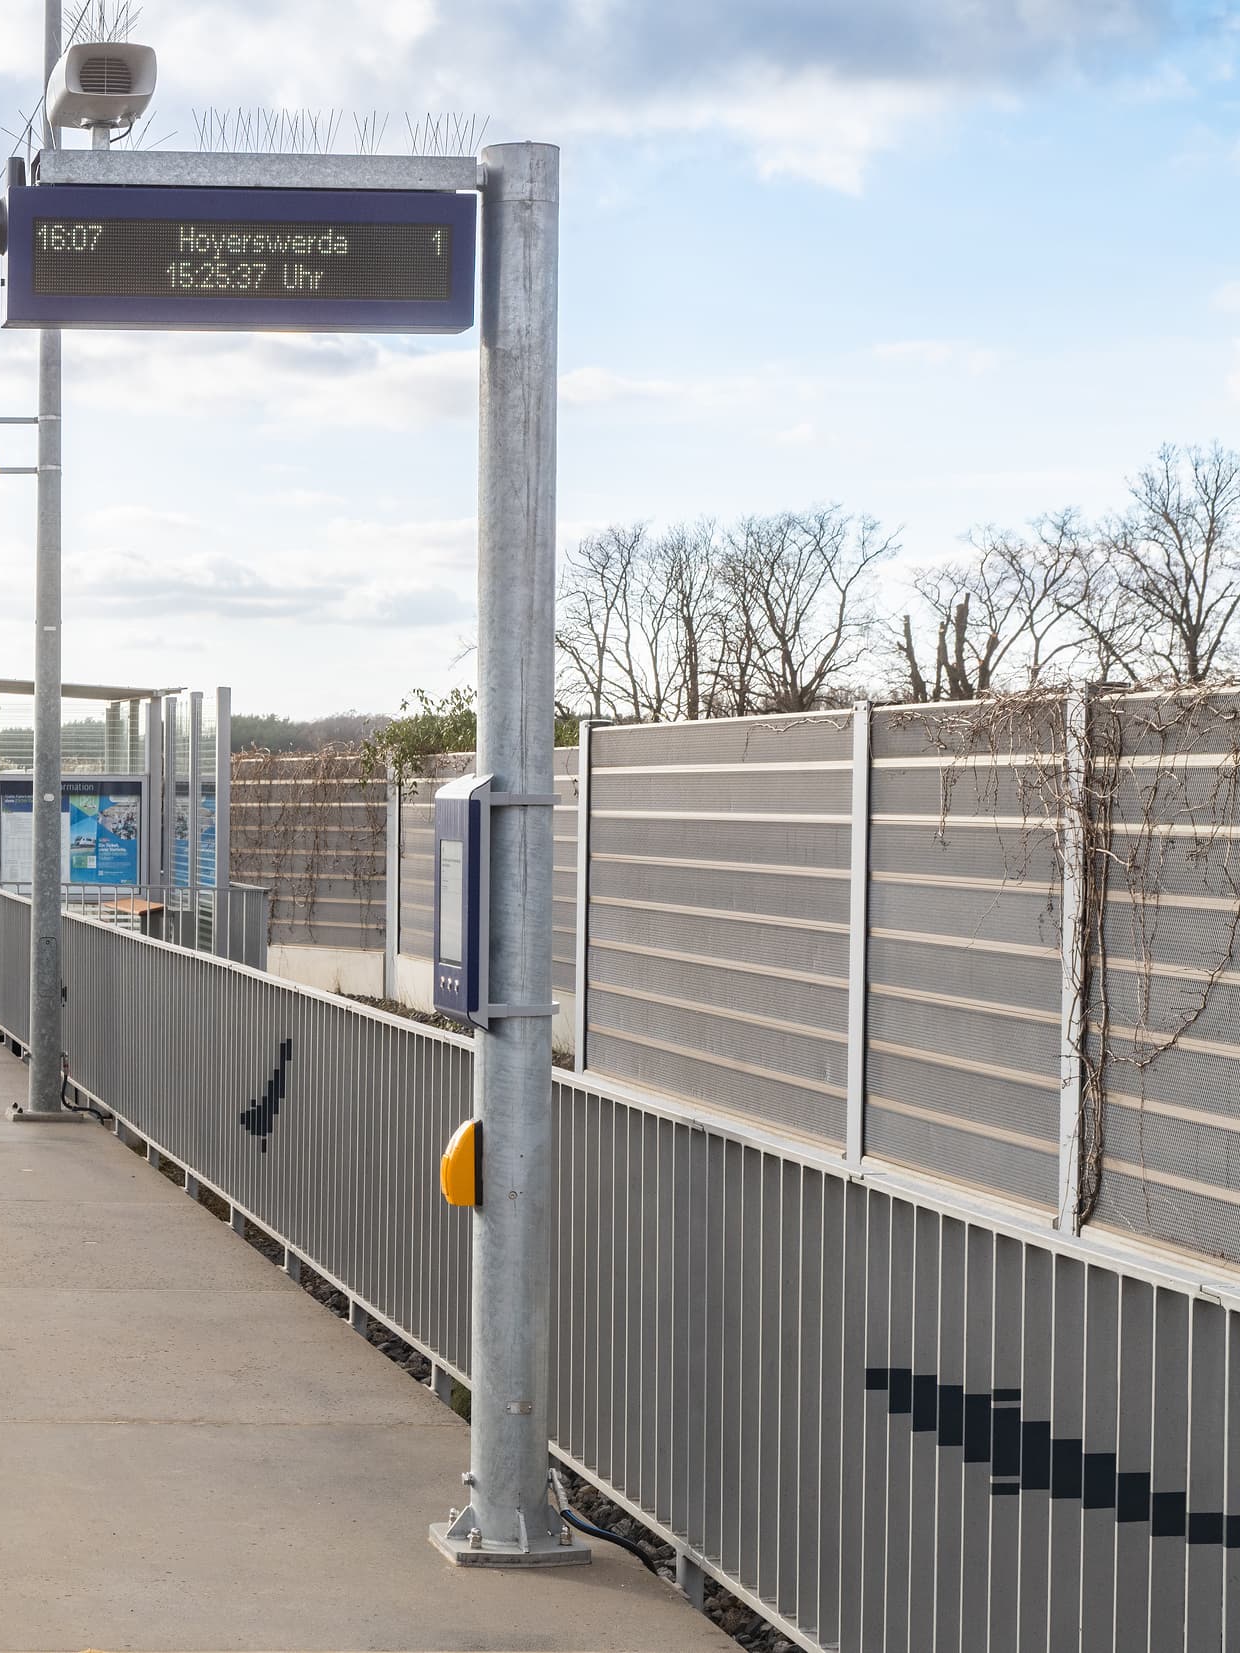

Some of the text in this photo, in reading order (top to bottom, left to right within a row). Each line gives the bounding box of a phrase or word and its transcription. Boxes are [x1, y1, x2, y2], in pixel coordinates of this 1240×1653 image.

[36, 224, 443, 259] 16:07 Hoyerswerda 1
[166, 263, 324, 290] 15:25:37 Uhr
[62, 783, 94, 791] rmation
